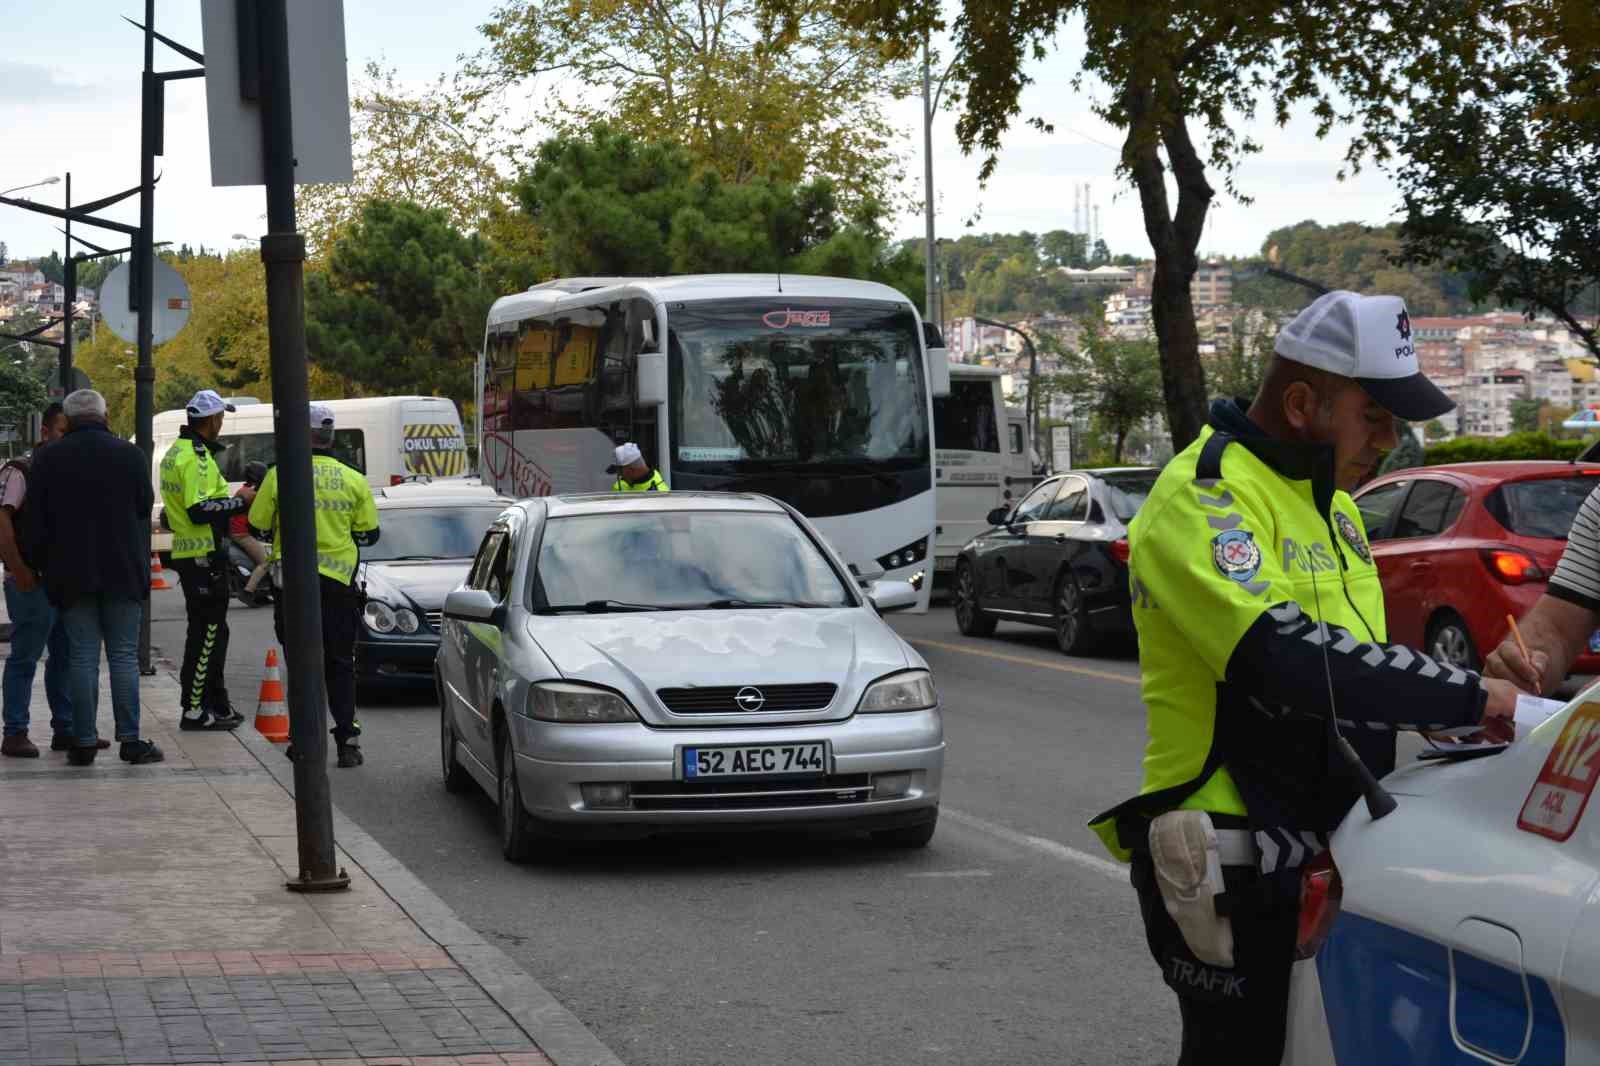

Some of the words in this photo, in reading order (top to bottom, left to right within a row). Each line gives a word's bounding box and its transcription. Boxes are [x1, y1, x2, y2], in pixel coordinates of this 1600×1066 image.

[405, 438, 436, 451] OKUL
[698, 751, 725, 774] 52
[732, 749, 776, 773] AEC
[782, 746, 822, 771] 744
[1550, 714, 1600, 782] 112
